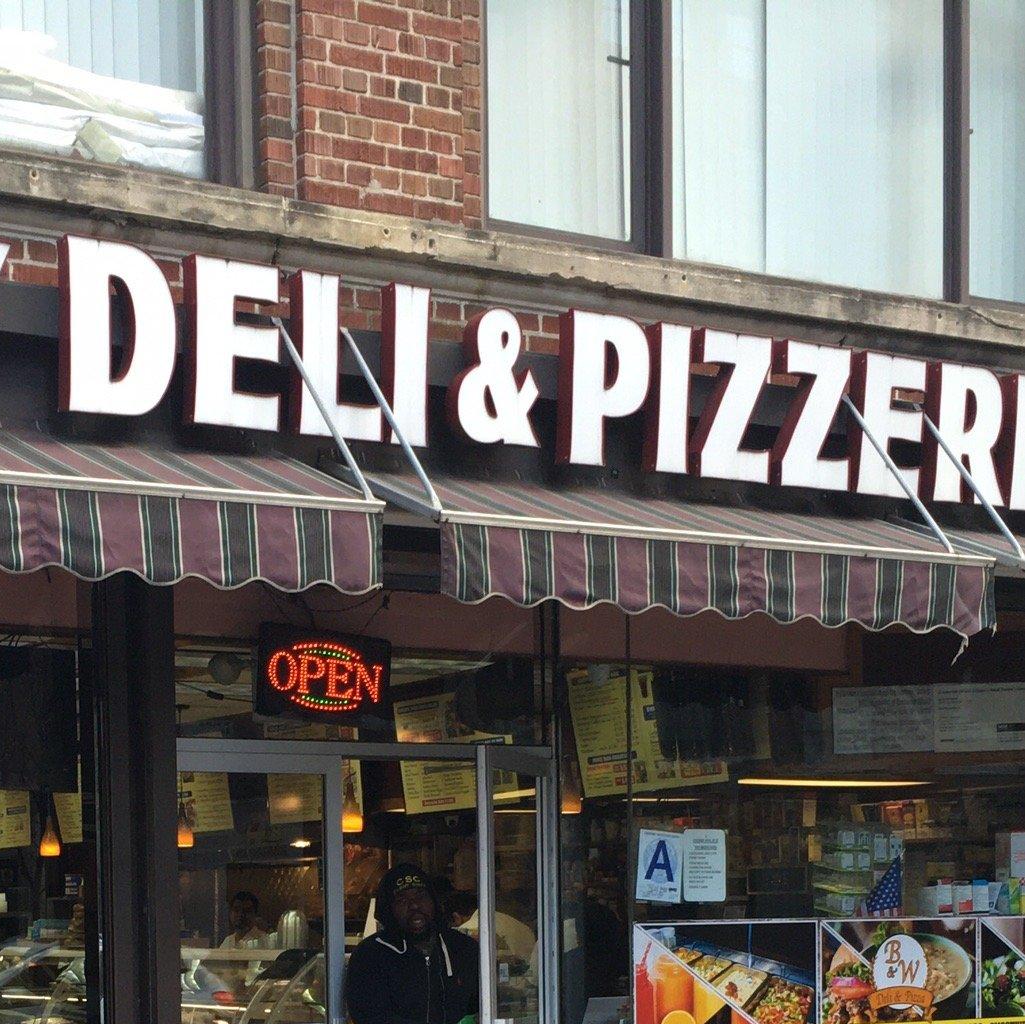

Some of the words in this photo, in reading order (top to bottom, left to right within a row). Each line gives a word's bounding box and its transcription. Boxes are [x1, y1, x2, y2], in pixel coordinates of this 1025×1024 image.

[66, 234, 432, 449] DELI
[456, 307, 541, 448] &
[267, 651, 383, 703] OPEN
[644, 839, 674, 882] A
[884, 939, 902, 964] B
[898, 959, 920, 984] W
